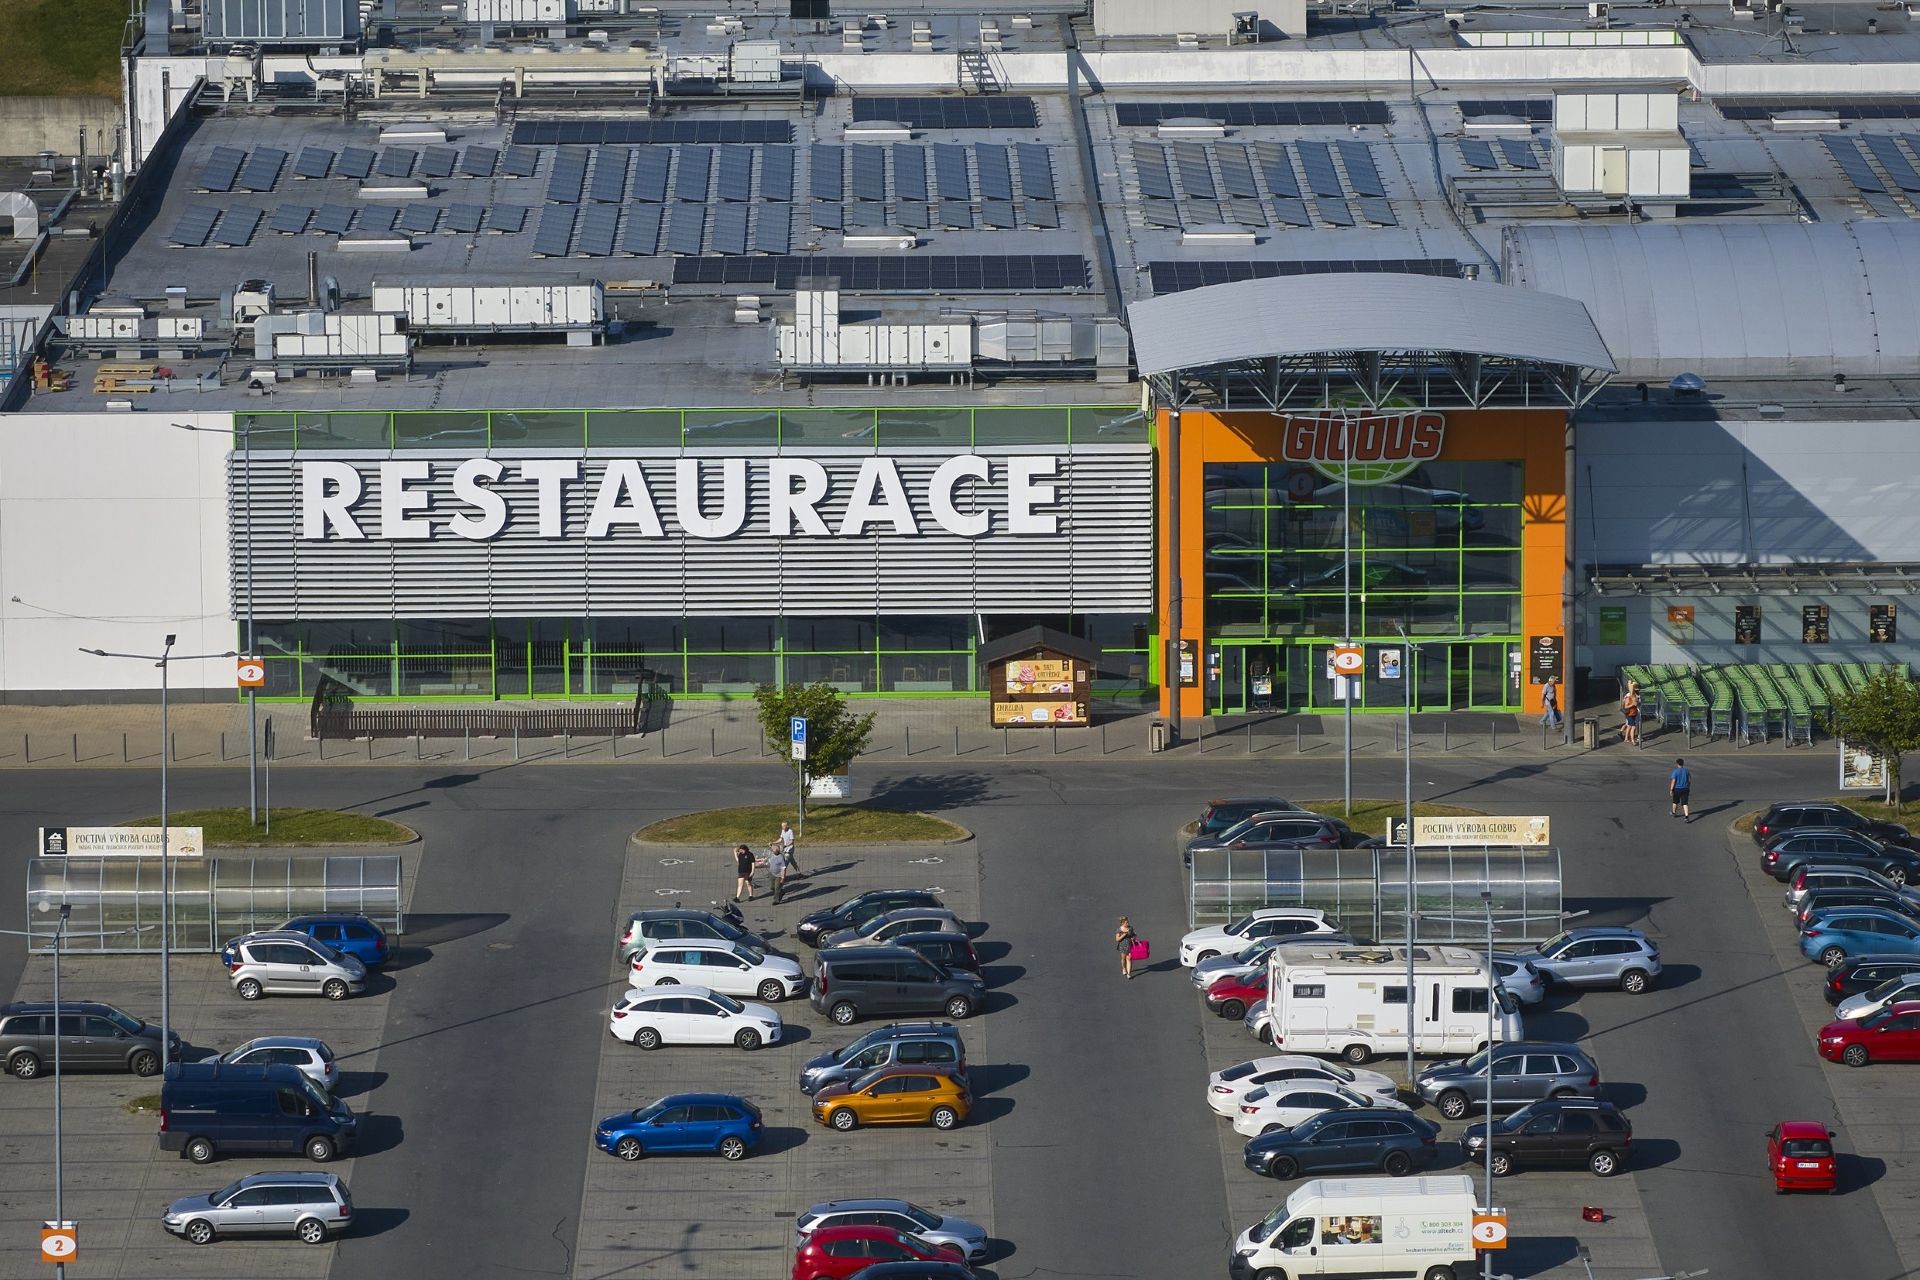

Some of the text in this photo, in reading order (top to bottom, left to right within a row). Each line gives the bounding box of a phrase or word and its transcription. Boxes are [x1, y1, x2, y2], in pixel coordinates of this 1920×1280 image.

[302, 455, 1058, 540] RESTAURACE
[1346, 656, 1353, 665] 3
[247, 668, 254, 678] 2
[795, 721, 802, 734] P
[1422, 822, 1517, 833] POCTIVÁ VÝROBA GLOBUS
[75, 832, 106, 843] POCTIVÁ
[109, 832, 139, 843] VÝROBA
[1486, 1226, 1494, 1238] 3
[55, 1240, 63, 1251] 2
